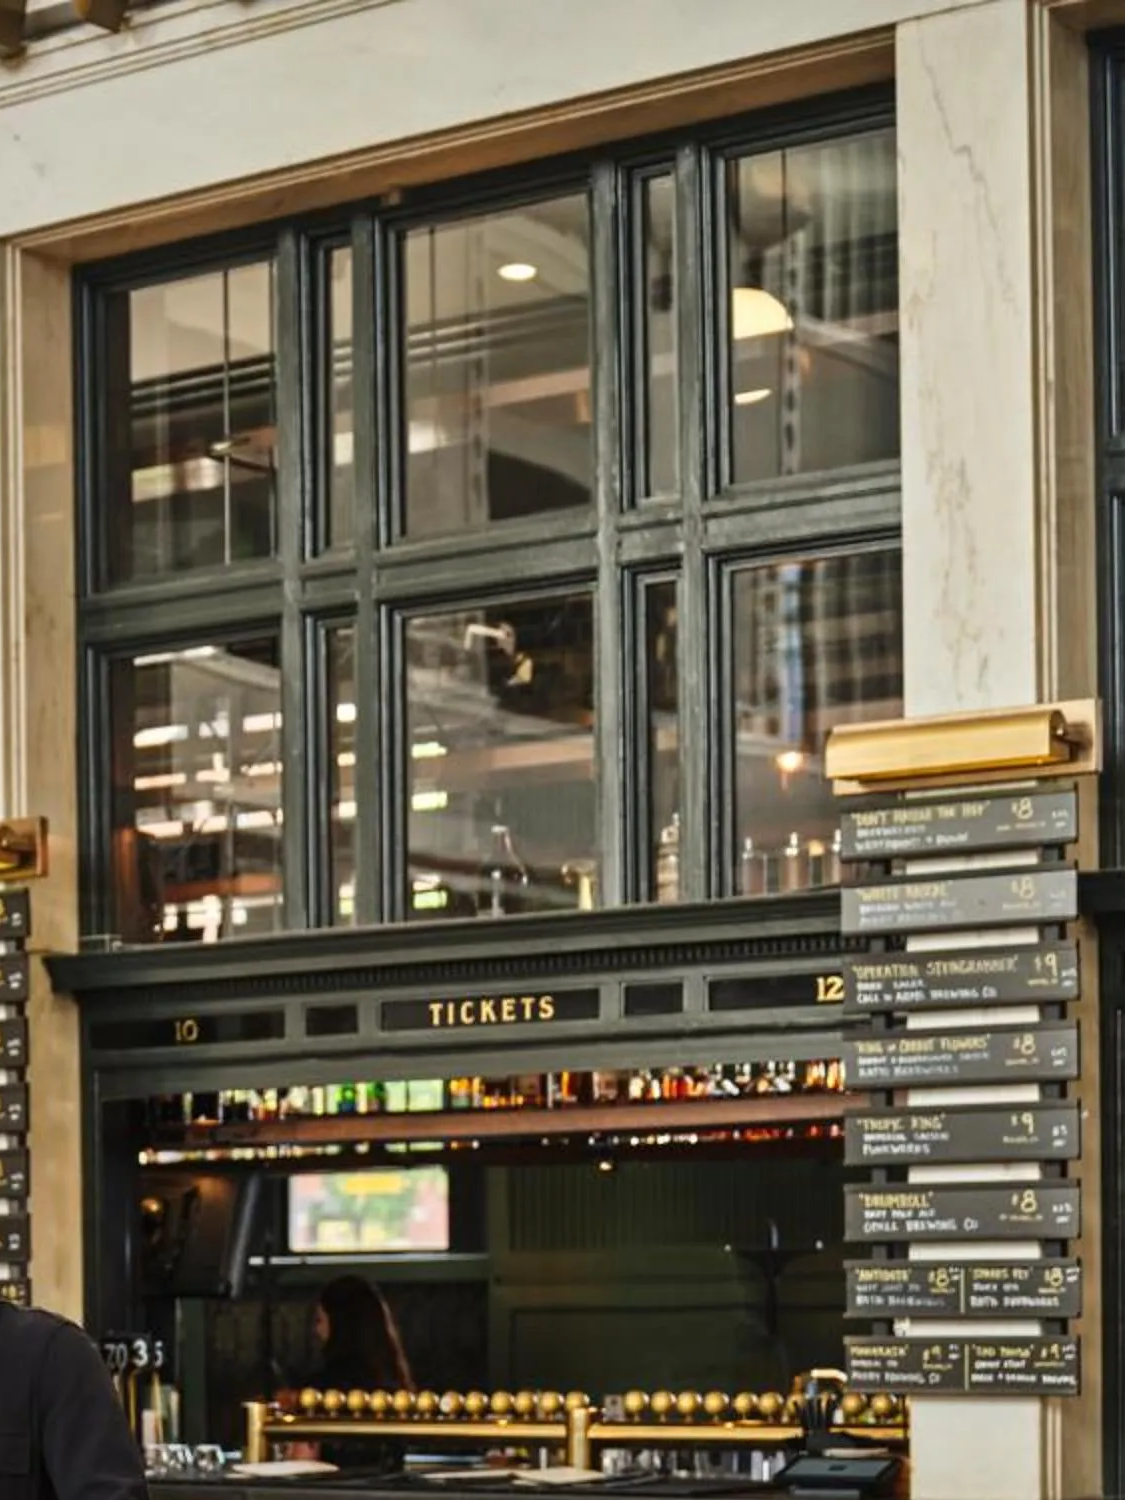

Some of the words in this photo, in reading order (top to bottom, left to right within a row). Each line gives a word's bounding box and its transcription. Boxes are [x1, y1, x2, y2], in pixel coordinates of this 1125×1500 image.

[815, 975, 845, 1002] 12
[428, 994, 555, 1026] TICKETS
[174, 1018, 199, 1043] 10
